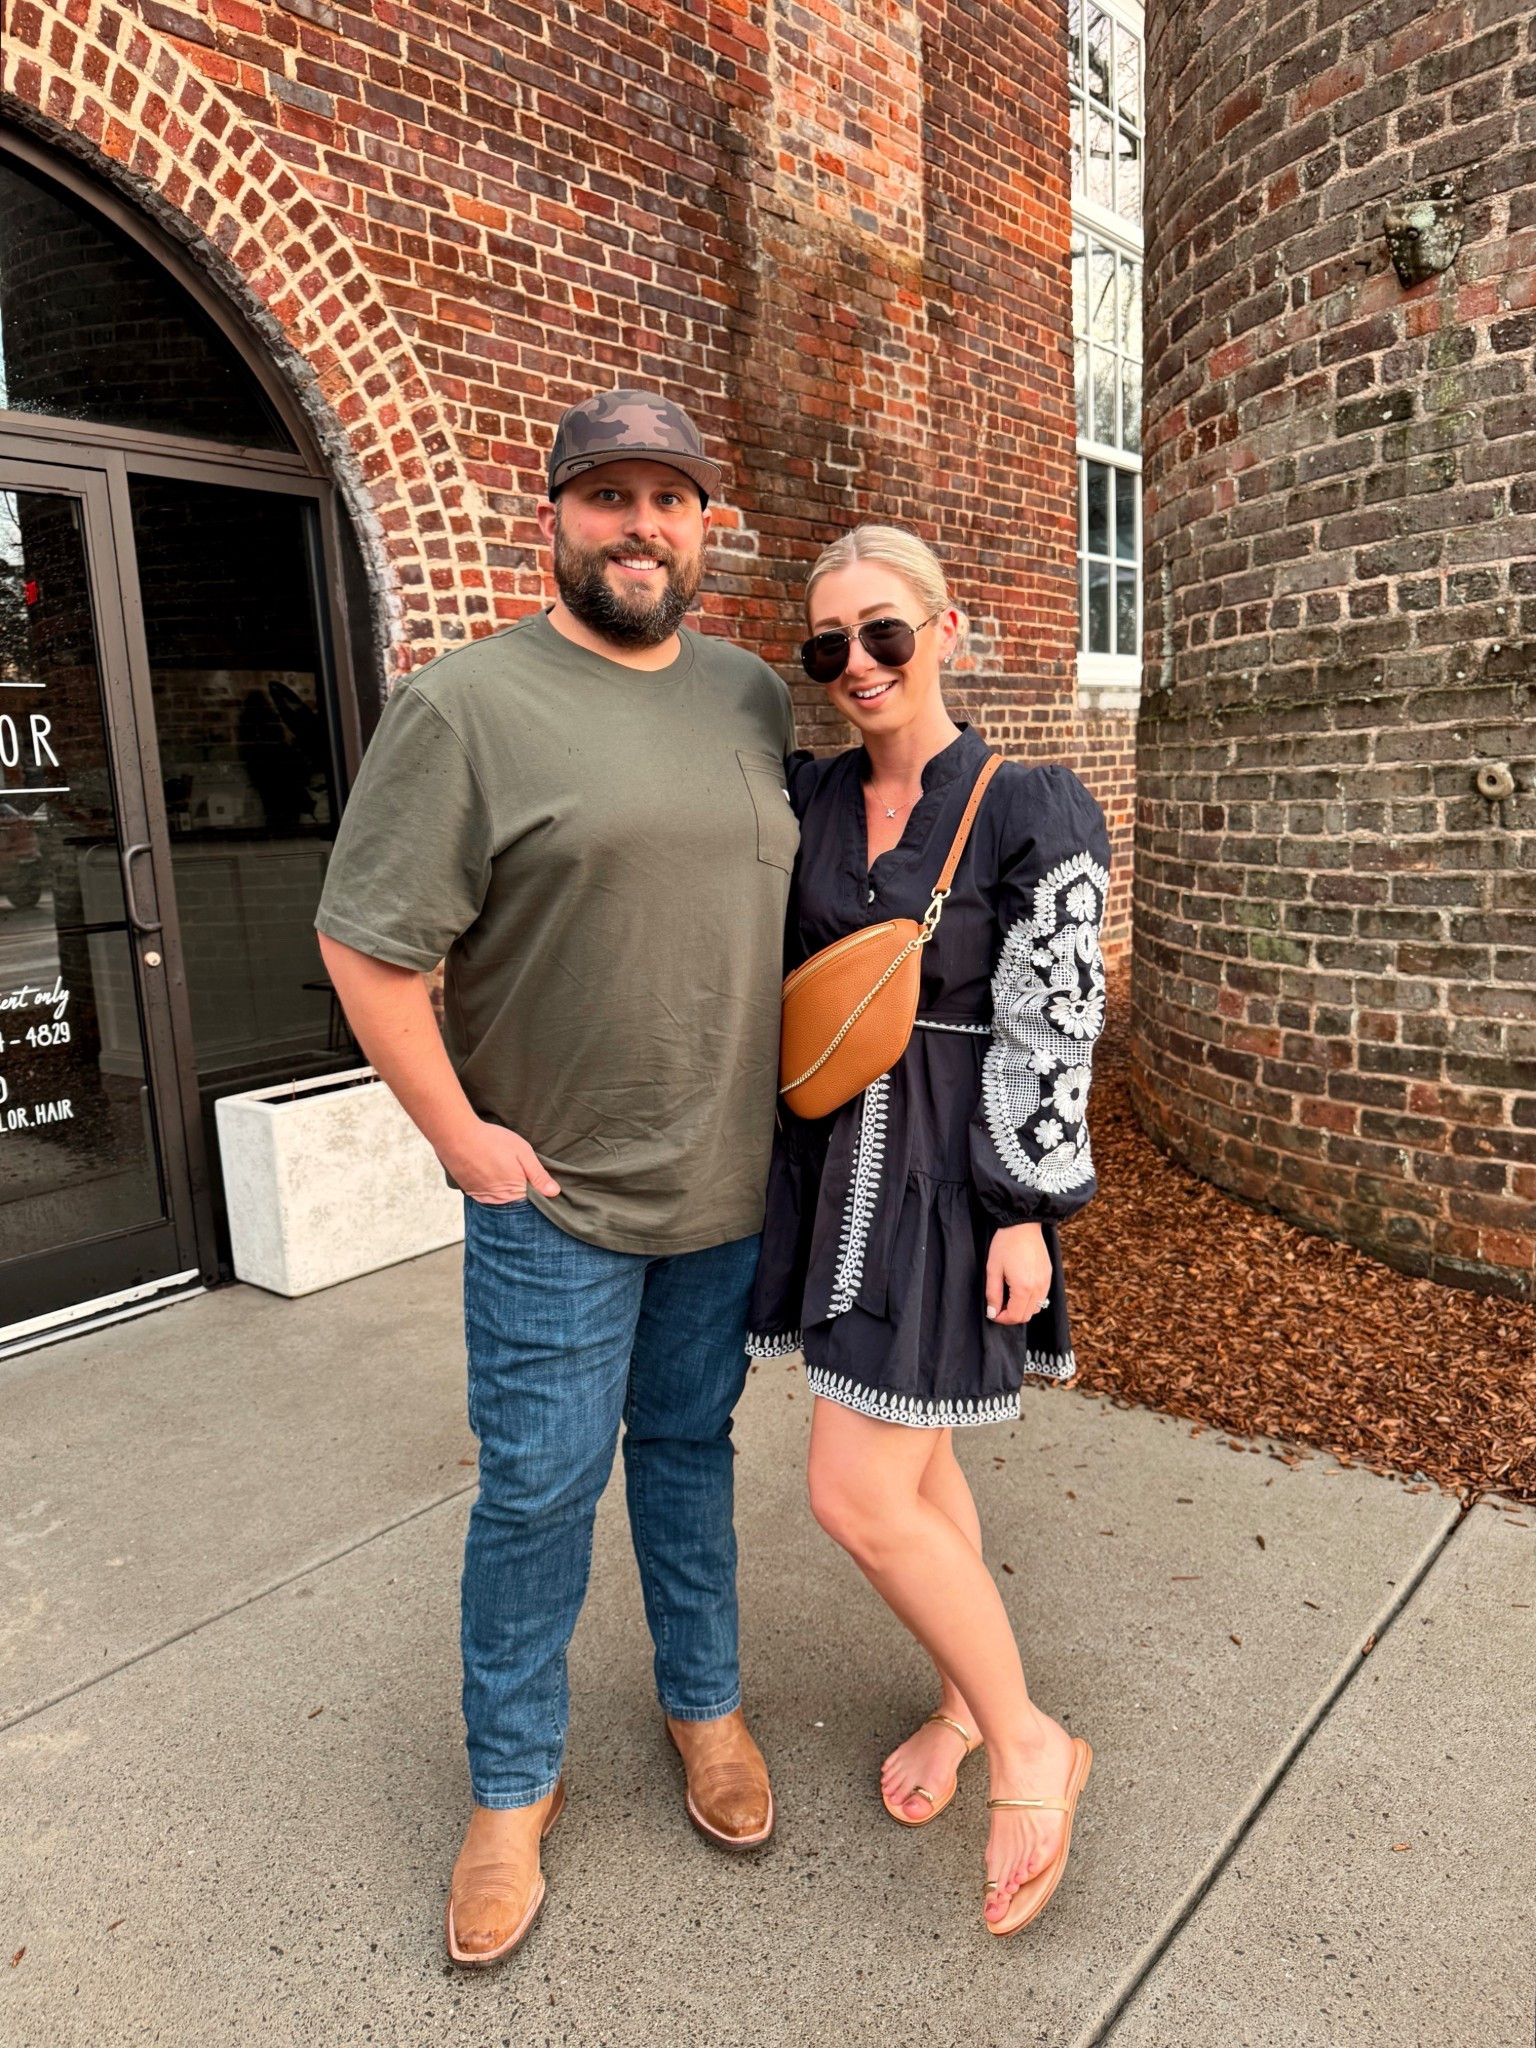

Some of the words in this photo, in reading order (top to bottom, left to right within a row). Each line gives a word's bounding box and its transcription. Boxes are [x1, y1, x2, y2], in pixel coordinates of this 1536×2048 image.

[0, 714, 59, 767] OR
[34, 975, 70, 1020] only
[0, 1098, 74, 1132] LOR.HAIR
